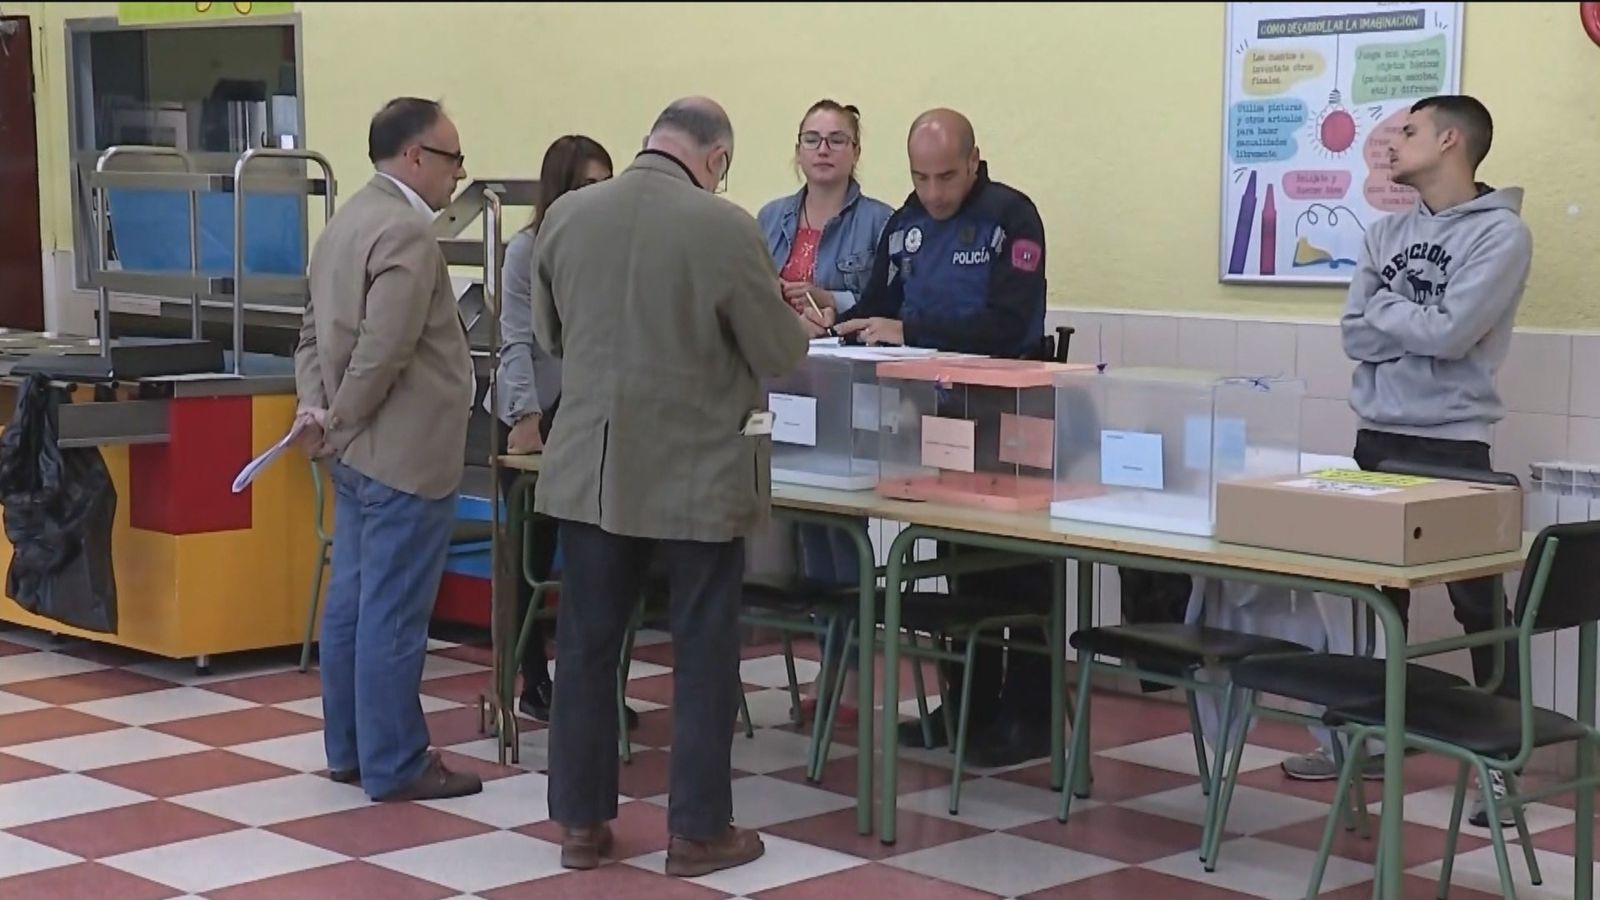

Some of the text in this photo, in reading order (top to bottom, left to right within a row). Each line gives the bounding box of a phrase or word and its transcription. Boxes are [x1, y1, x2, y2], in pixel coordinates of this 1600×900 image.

[1288, 19, 1344, 34] DESARROLLAR
[1345, 17, 1357, 31] LA
[1268, 103, 1303, 114] pinturas
[1236, 117, 1242, 127] y
[1245, 115, 1265, 124] otros
[1236, 126, 1279, 137] para hacer
[1236, 137, 1288, 147] manualidades
[1332, 175, 1337, 185] y
[952, 246, 991, 265] POLICÍA
